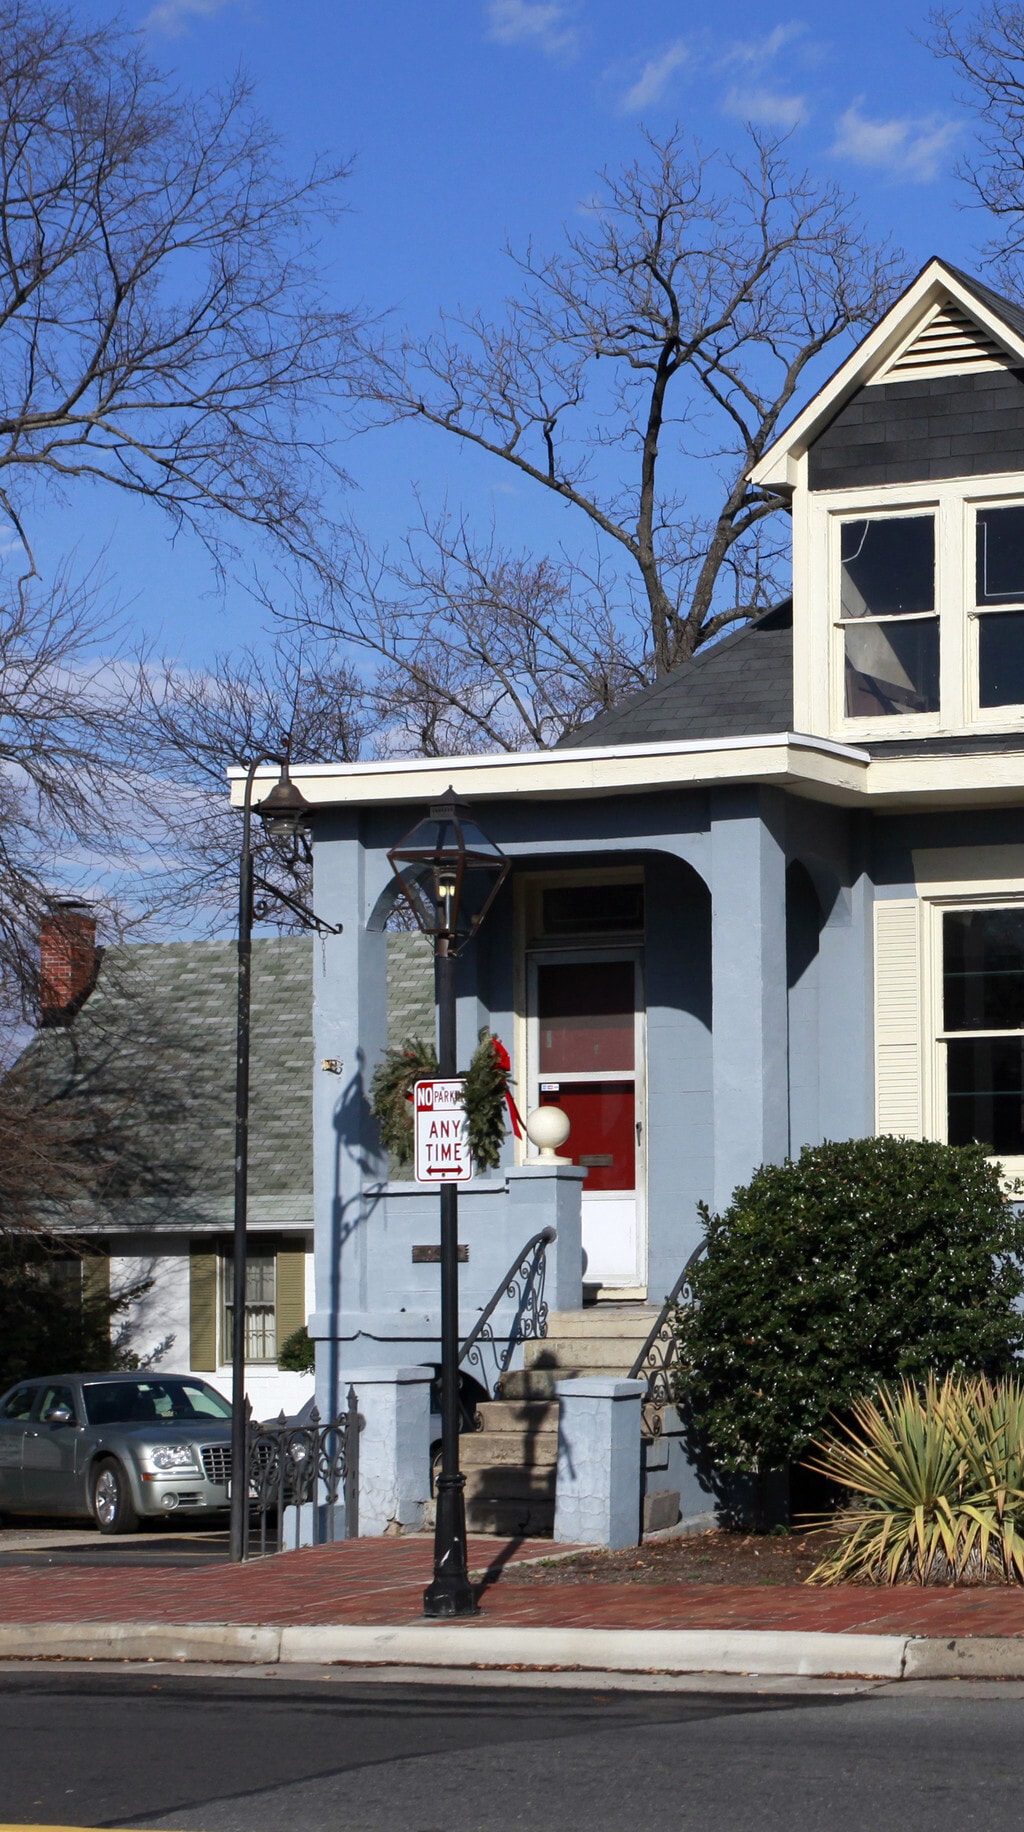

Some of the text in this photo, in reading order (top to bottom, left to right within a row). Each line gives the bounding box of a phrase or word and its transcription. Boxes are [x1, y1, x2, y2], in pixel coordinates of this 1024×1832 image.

[418, 1087, 433, 1106] NO
[429, 1120, 461, 1138] ANY
[425, 1143, 462, 1161] TIME
